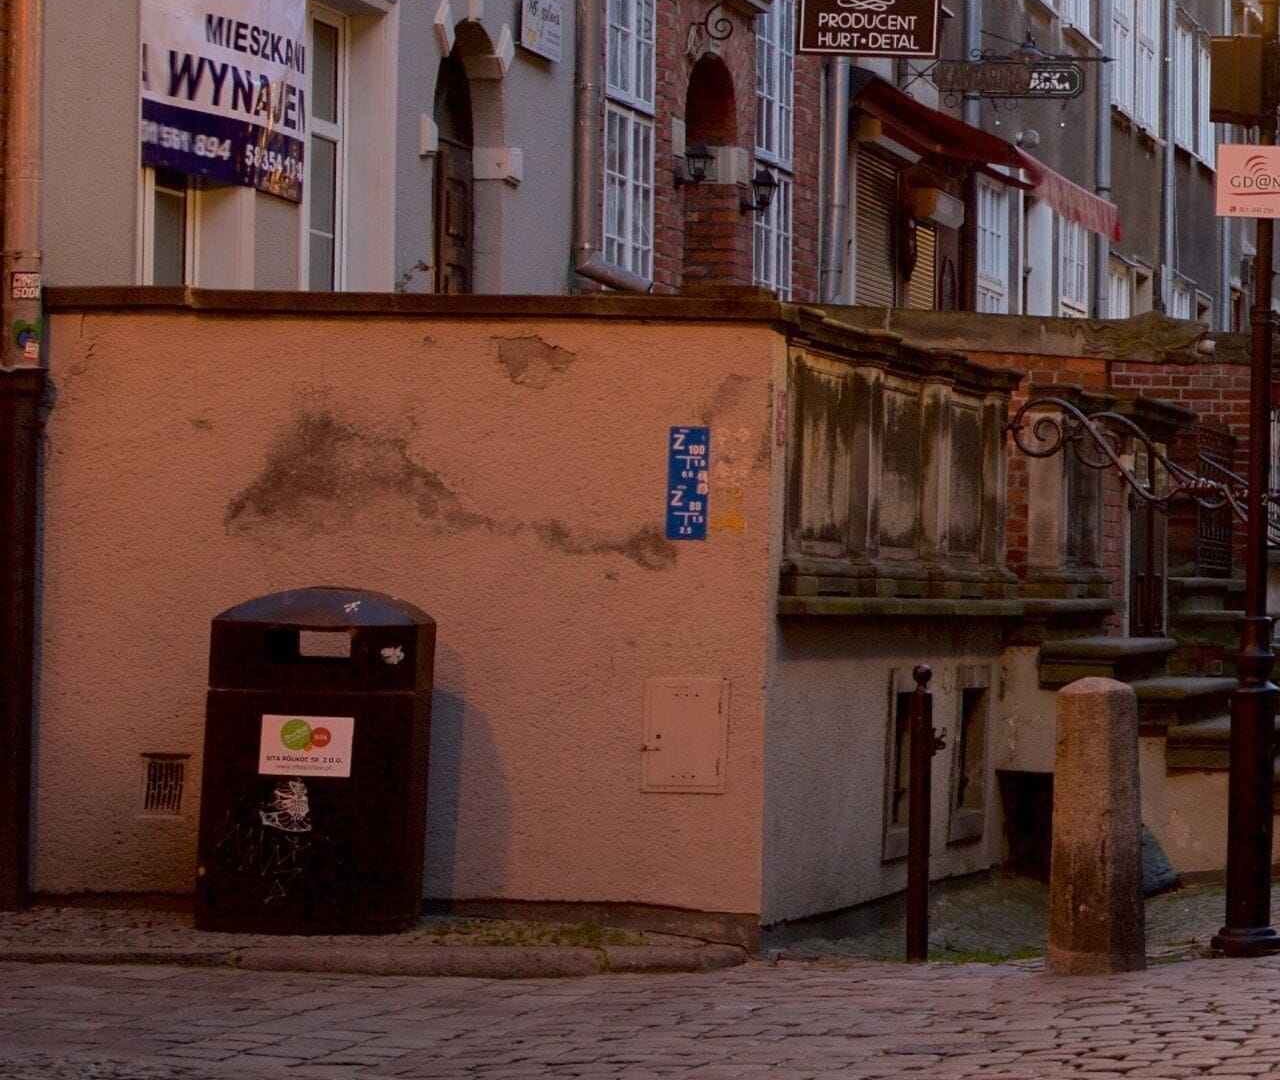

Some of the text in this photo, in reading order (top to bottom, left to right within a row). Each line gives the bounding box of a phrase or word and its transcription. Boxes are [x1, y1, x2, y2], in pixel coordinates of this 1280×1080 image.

[818, 13, 917, 31] PRODUCENT
[195, 134, 232, 160] 894
[673, 434, 685, 450] Z
[688, 445, 705, 455] 100
[671, 490, 683, 506] Z
